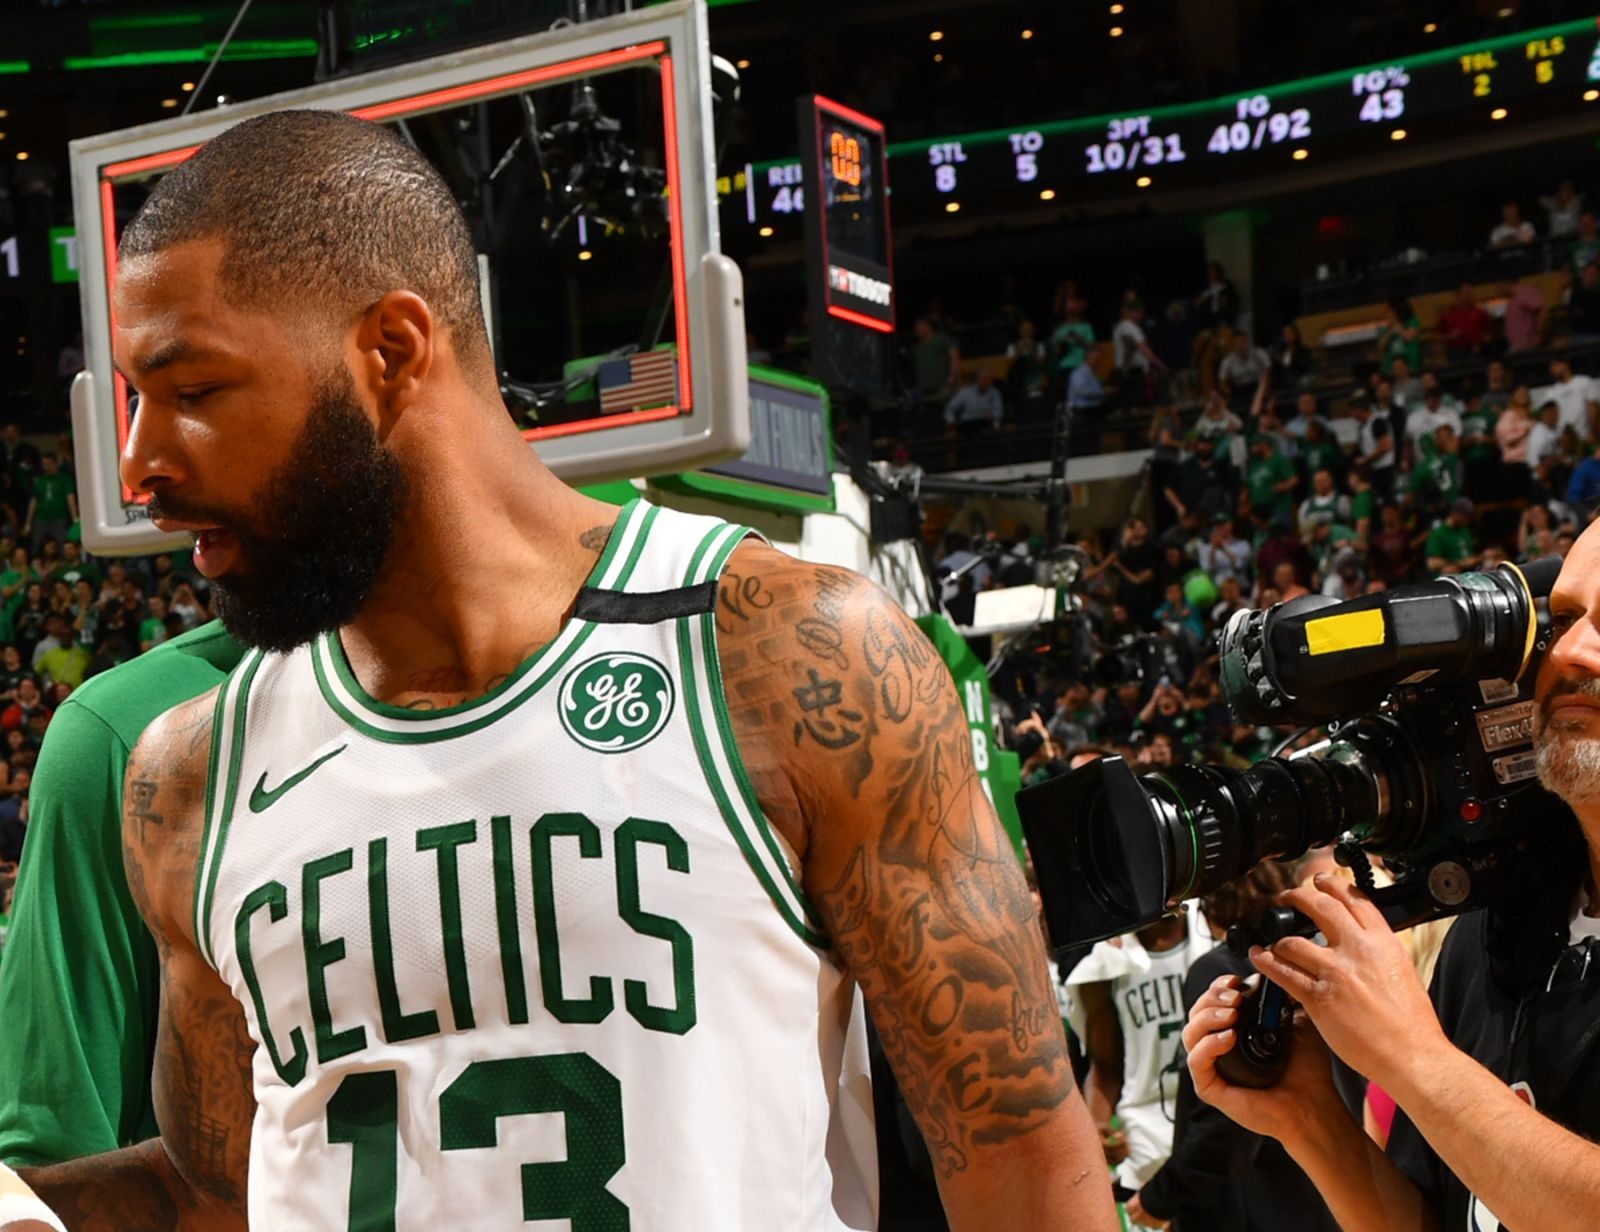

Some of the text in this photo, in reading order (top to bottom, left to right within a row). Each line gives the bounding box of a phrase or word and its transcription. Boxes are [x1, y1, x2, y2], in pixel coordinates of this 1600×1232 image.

[1352, 66, 1410, 96] FG%
[1473, 74, 1491, 97] 2
[1236, 95, 1270, 119] FG
[1359, 88, 1404, 122] 43
[1107, 115, 1151, 140] 3PT
[1207, 109, 1312, 154] 40/92
[928, 141, 968, 165] STL
[1009, 131, 1043, 153] TO
[1085, 133, 1186, 173] 10/31
[935, 164, 956, 192] 8
[1016, 154, 1038, 181] 5
[584, 672, 649, 730] GE
[235, 812, 697, 1087] CELTICS
